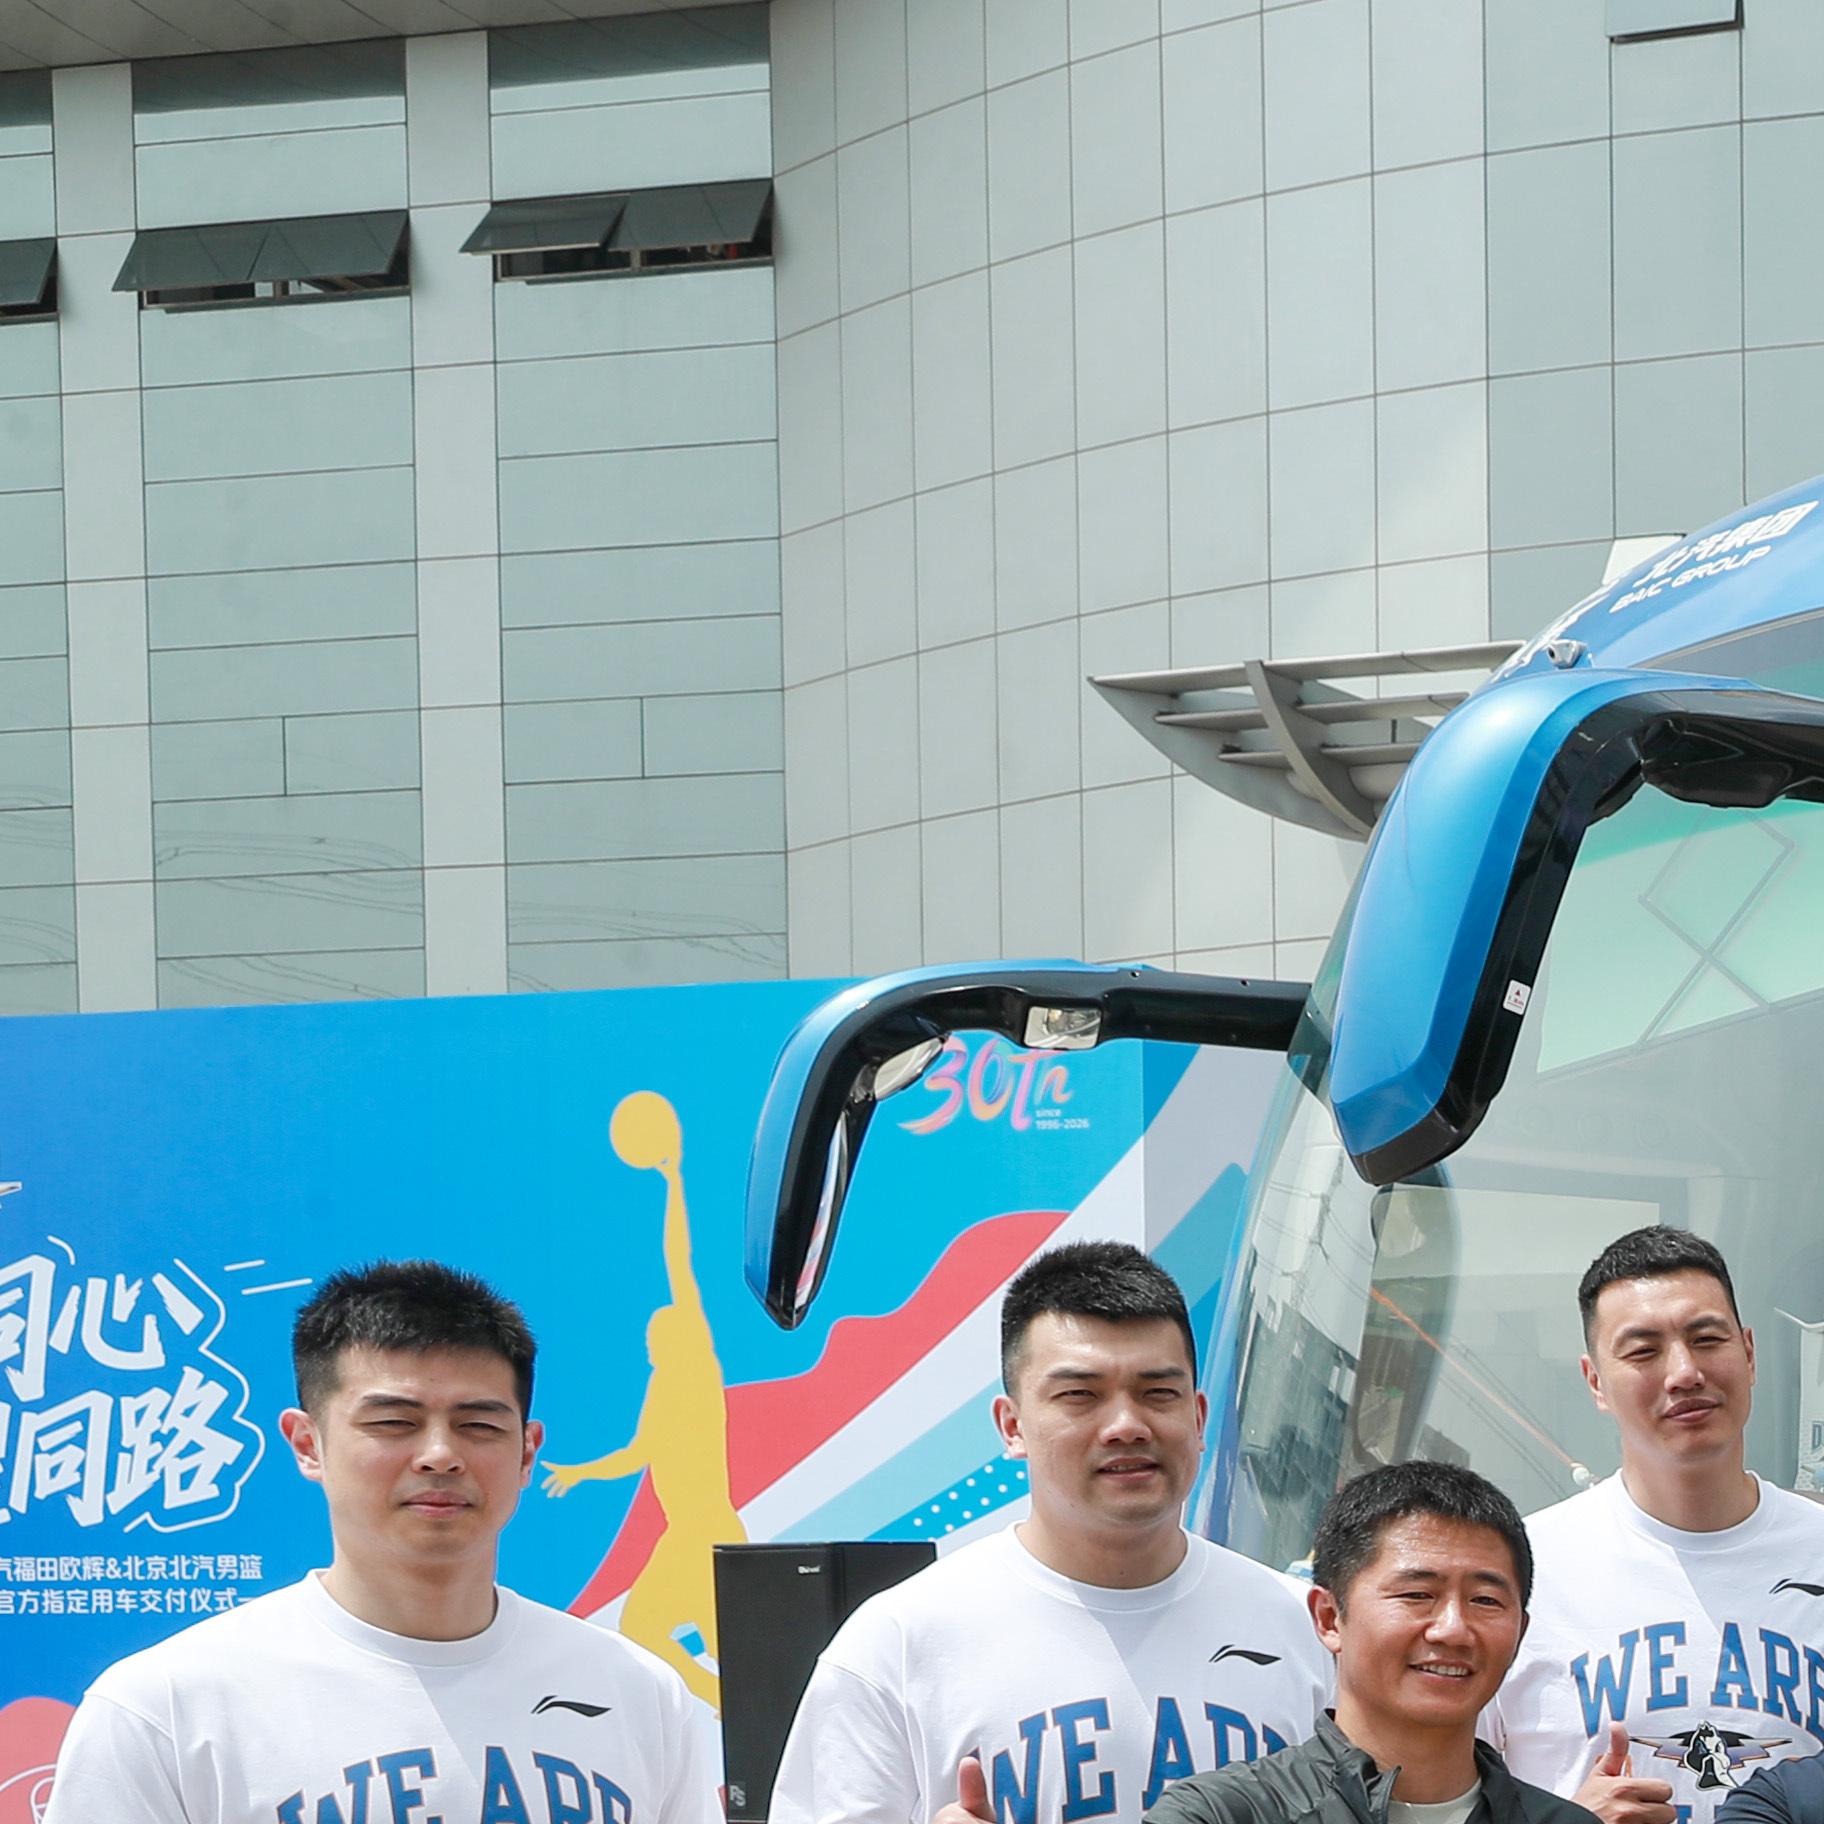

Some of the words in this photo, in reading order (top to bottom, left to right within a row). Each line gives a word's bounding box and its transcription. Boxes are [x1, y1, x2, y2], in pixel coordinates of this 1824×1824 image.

[1671, 545, 1772, 588] GROUP
[0, 1365, 244, 1528] 同路
[1569, 1620, 1690, 1740] WE
